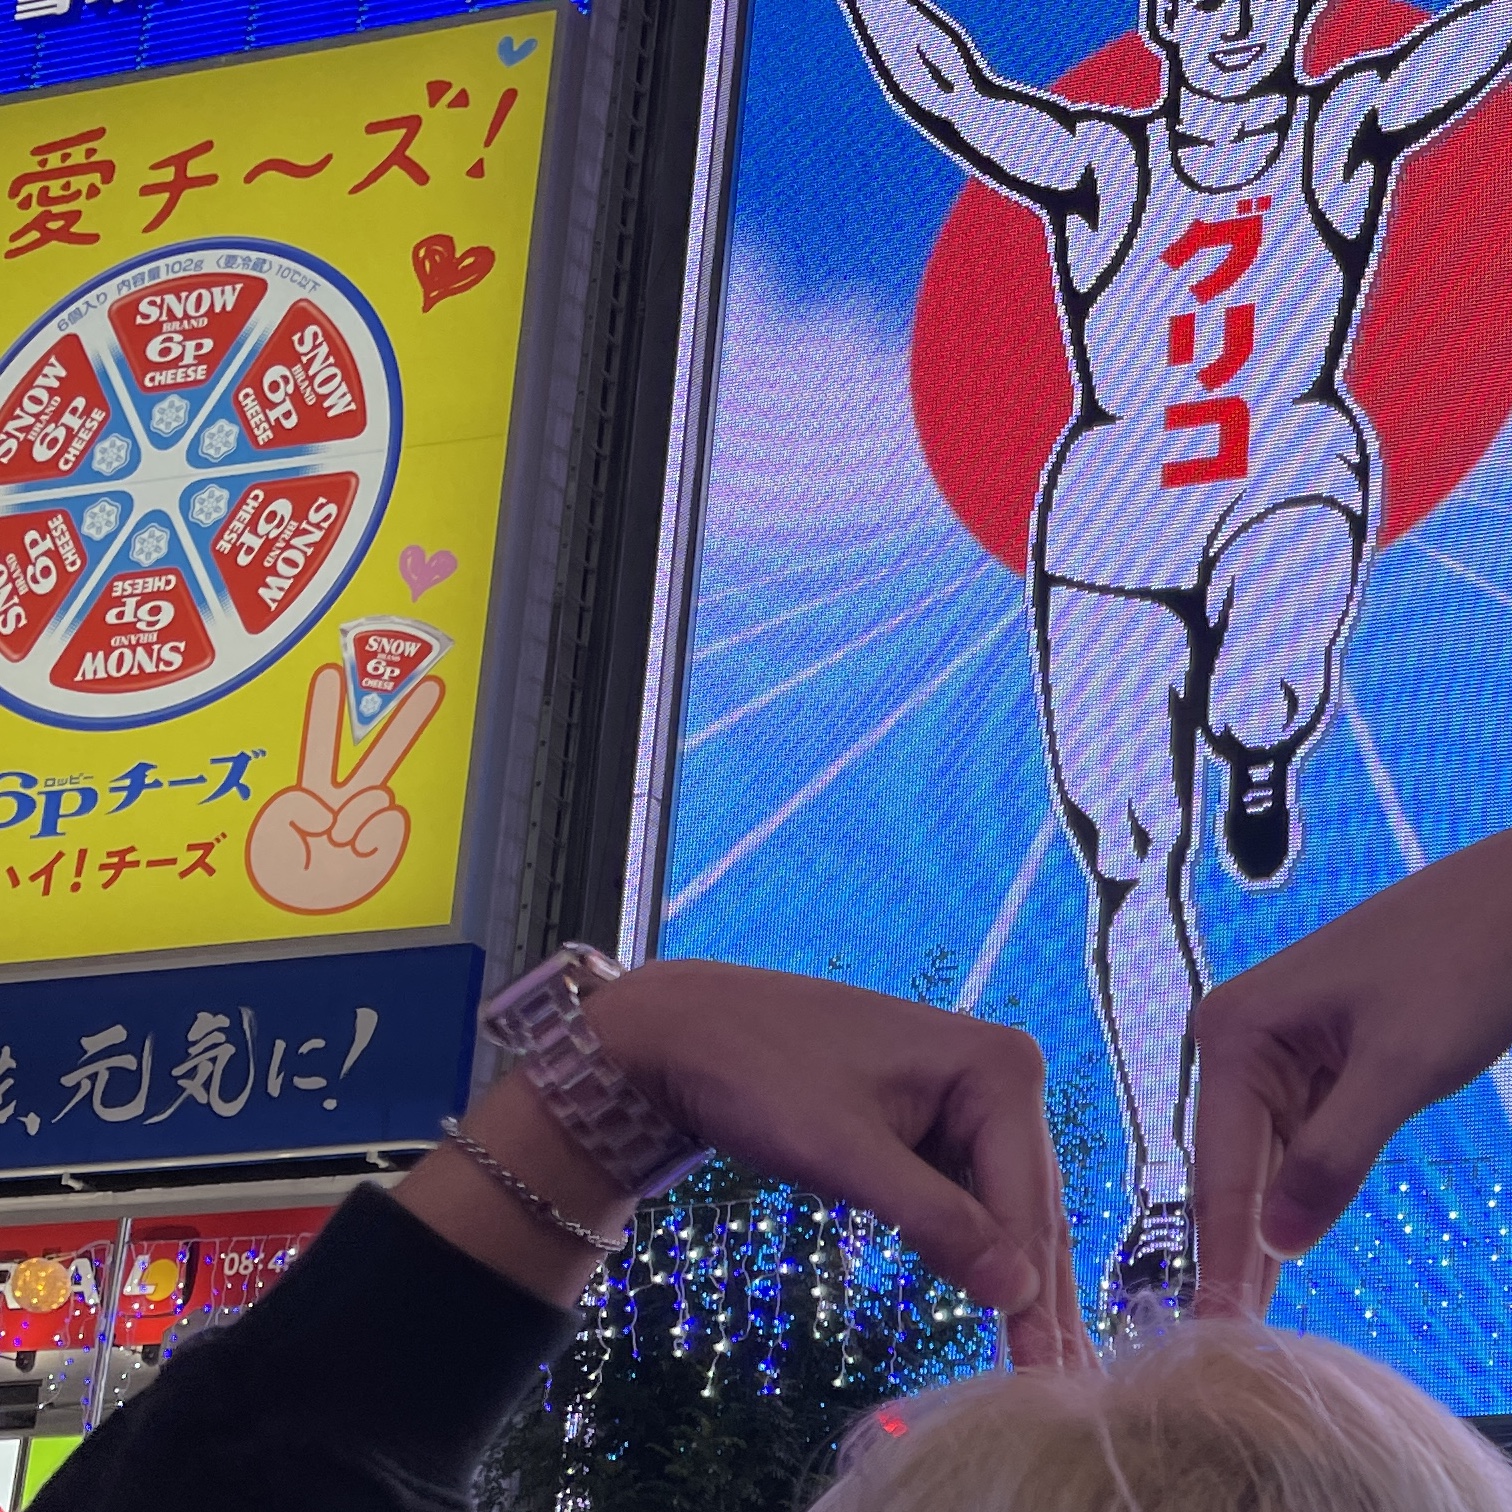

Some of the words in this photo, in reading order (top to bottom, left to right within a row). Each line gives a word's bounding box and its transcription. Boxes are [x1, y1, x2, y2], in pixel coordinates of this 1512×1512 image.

[135, 283, 243, 326] SNOW
[162, 316, 208, 333] BRAND
[1160, 196, 1271, 488] グリコ
[143, 364, 207, 388] CHEESE
[291, 324, 357, 418] SNOW
[291, 363, 317, 406] BRAND
[27, 396, 61, 441] BRAND
[58, 407, 106, 471] CHEESE
[237, 387, 274, 446] CHEESE
[47, 514, 82, 573] CHEESE
[215, 488, 265, 554] CHEESE
[257, 496, 338, 612] SNOW
[262, 520, 299, 568] BRAND
[111, 574, 177, 598] CHEESE
[73, 641, 186, 682] SNOW
[110, 631, 158, 647] BRAND
[364, 635, 421, 658] SNOW
